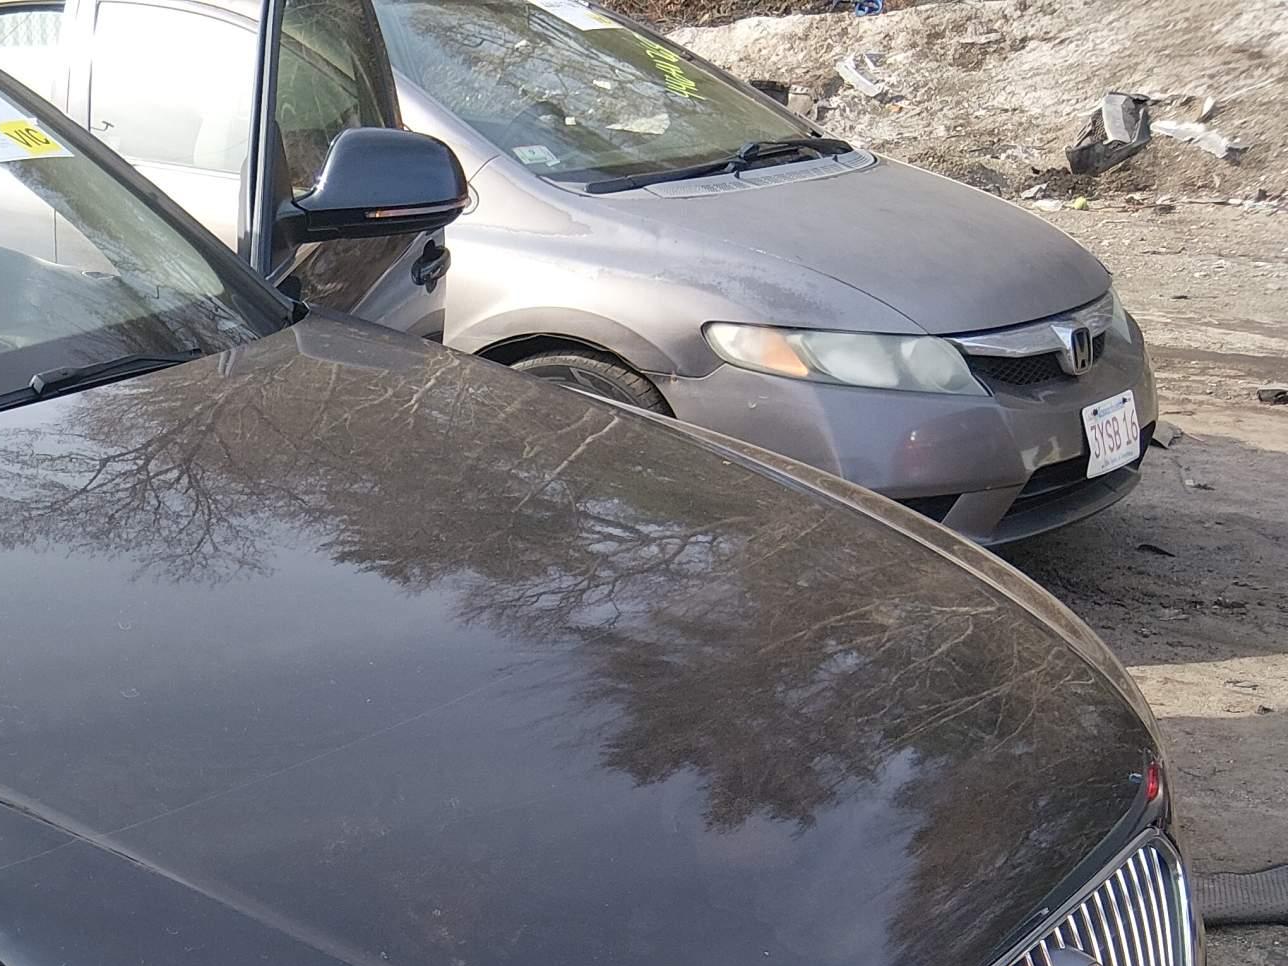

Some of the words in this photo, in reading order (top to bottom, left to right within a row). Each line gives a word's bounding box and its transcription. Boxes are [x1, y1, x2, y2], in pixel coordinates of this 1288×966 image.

[5, 127, 51, 148] VIC
[1090, 416, 1122, 458] 3YSB
[1123, 409, 1139, 446] 16
